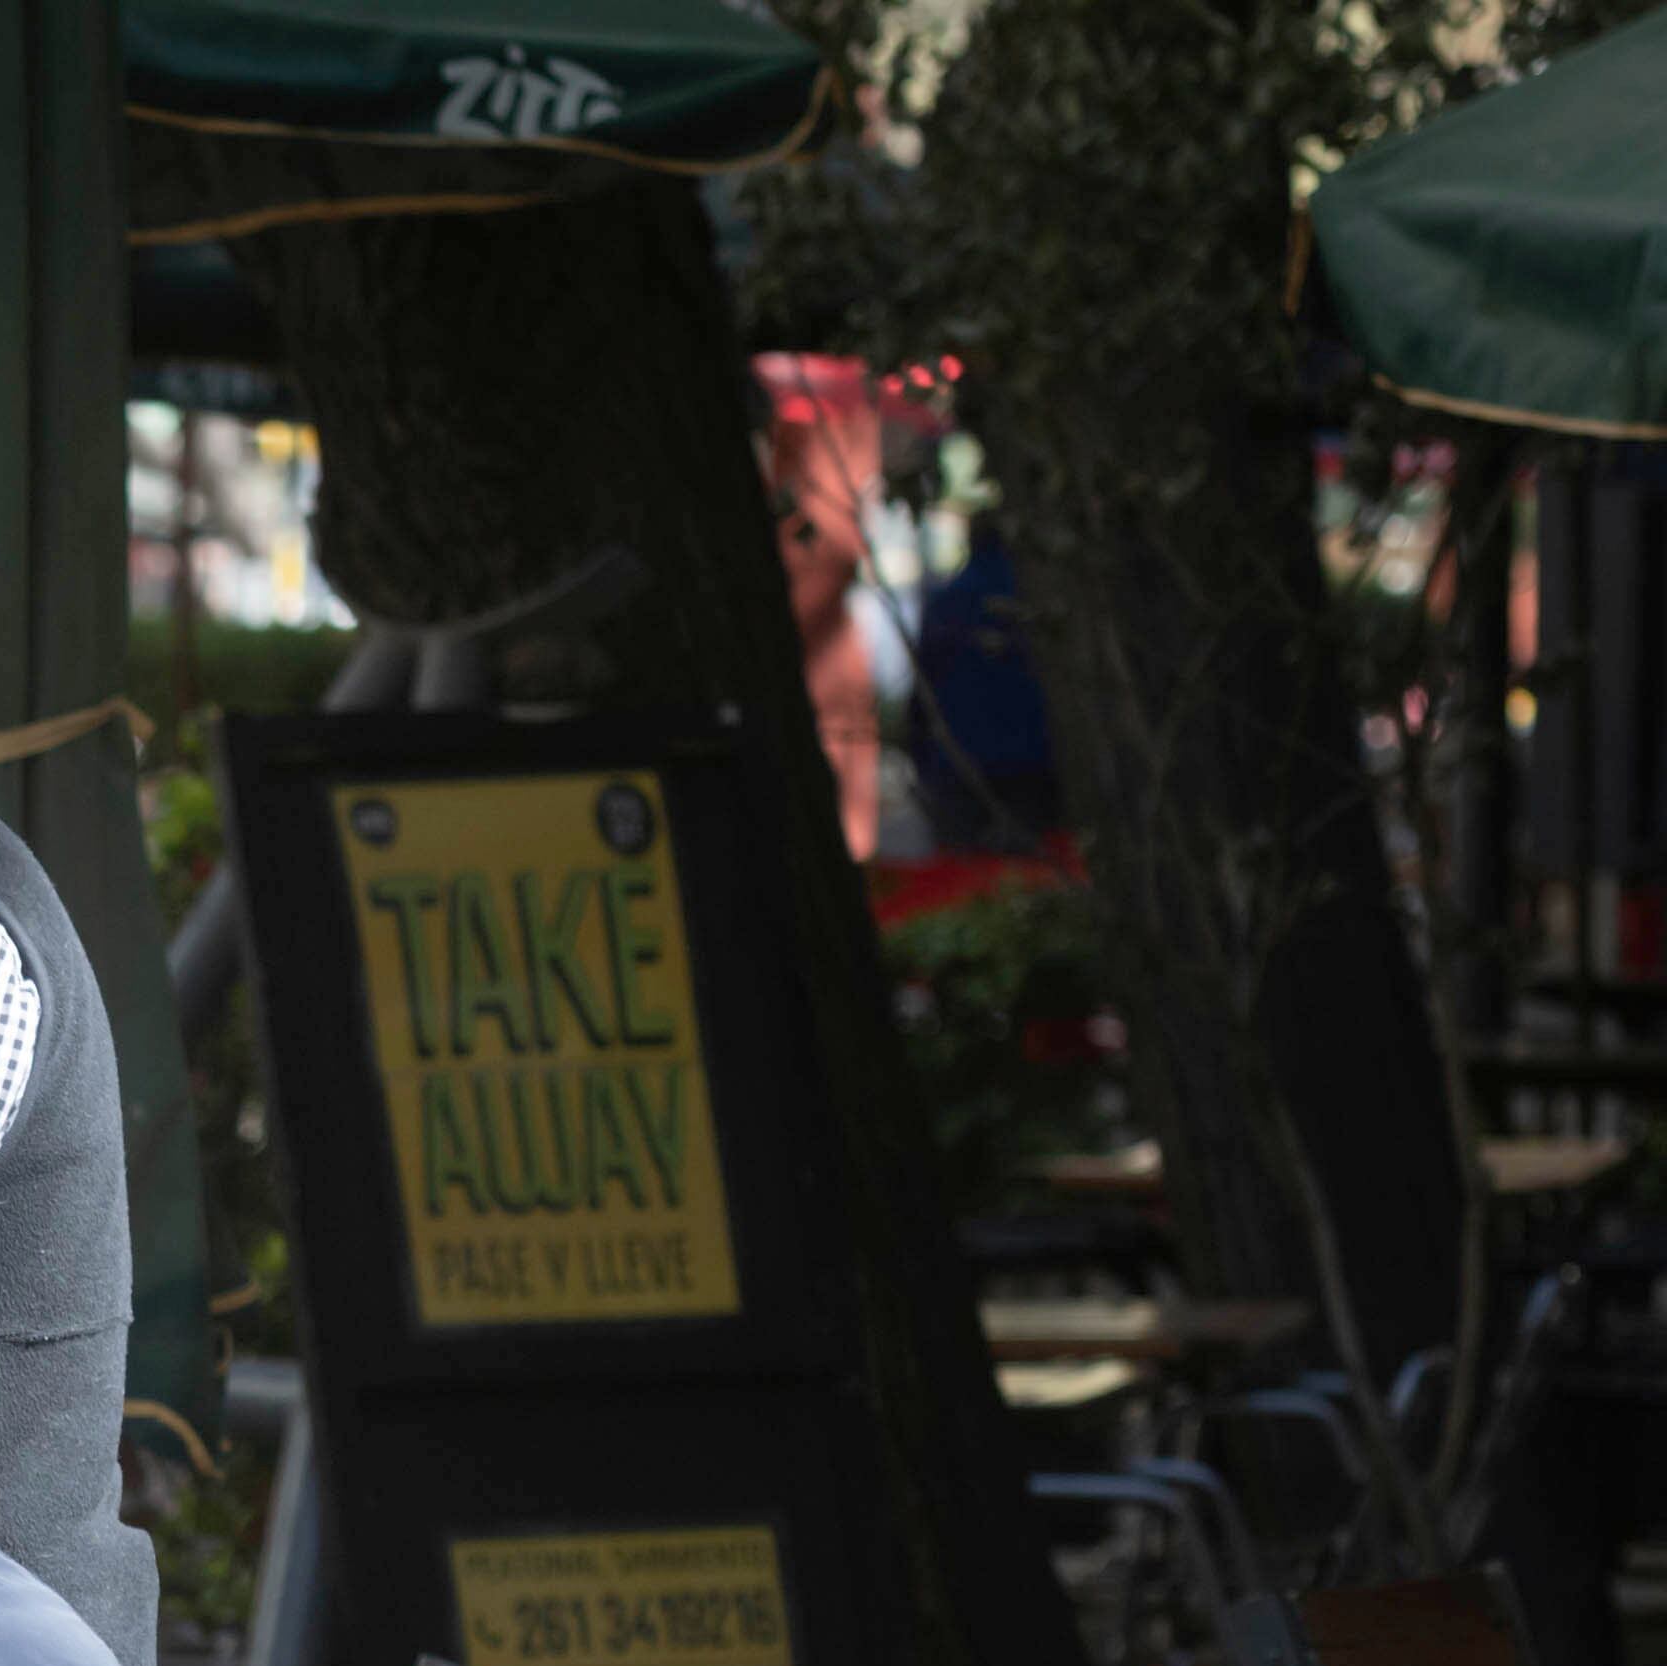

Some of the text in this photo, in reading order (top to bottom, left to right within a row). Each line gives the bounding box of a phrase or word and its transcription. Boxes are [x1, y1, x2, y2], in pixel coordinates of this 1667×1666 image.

[368, 862, 673, 1060] TAKE
[421, 1066, 688, 1217] AWAY
[540, 1236, 569, 1293] Y
[578, 1228, 695, 1296] LLEVE
[514, 1593, 593, 1658] 261
